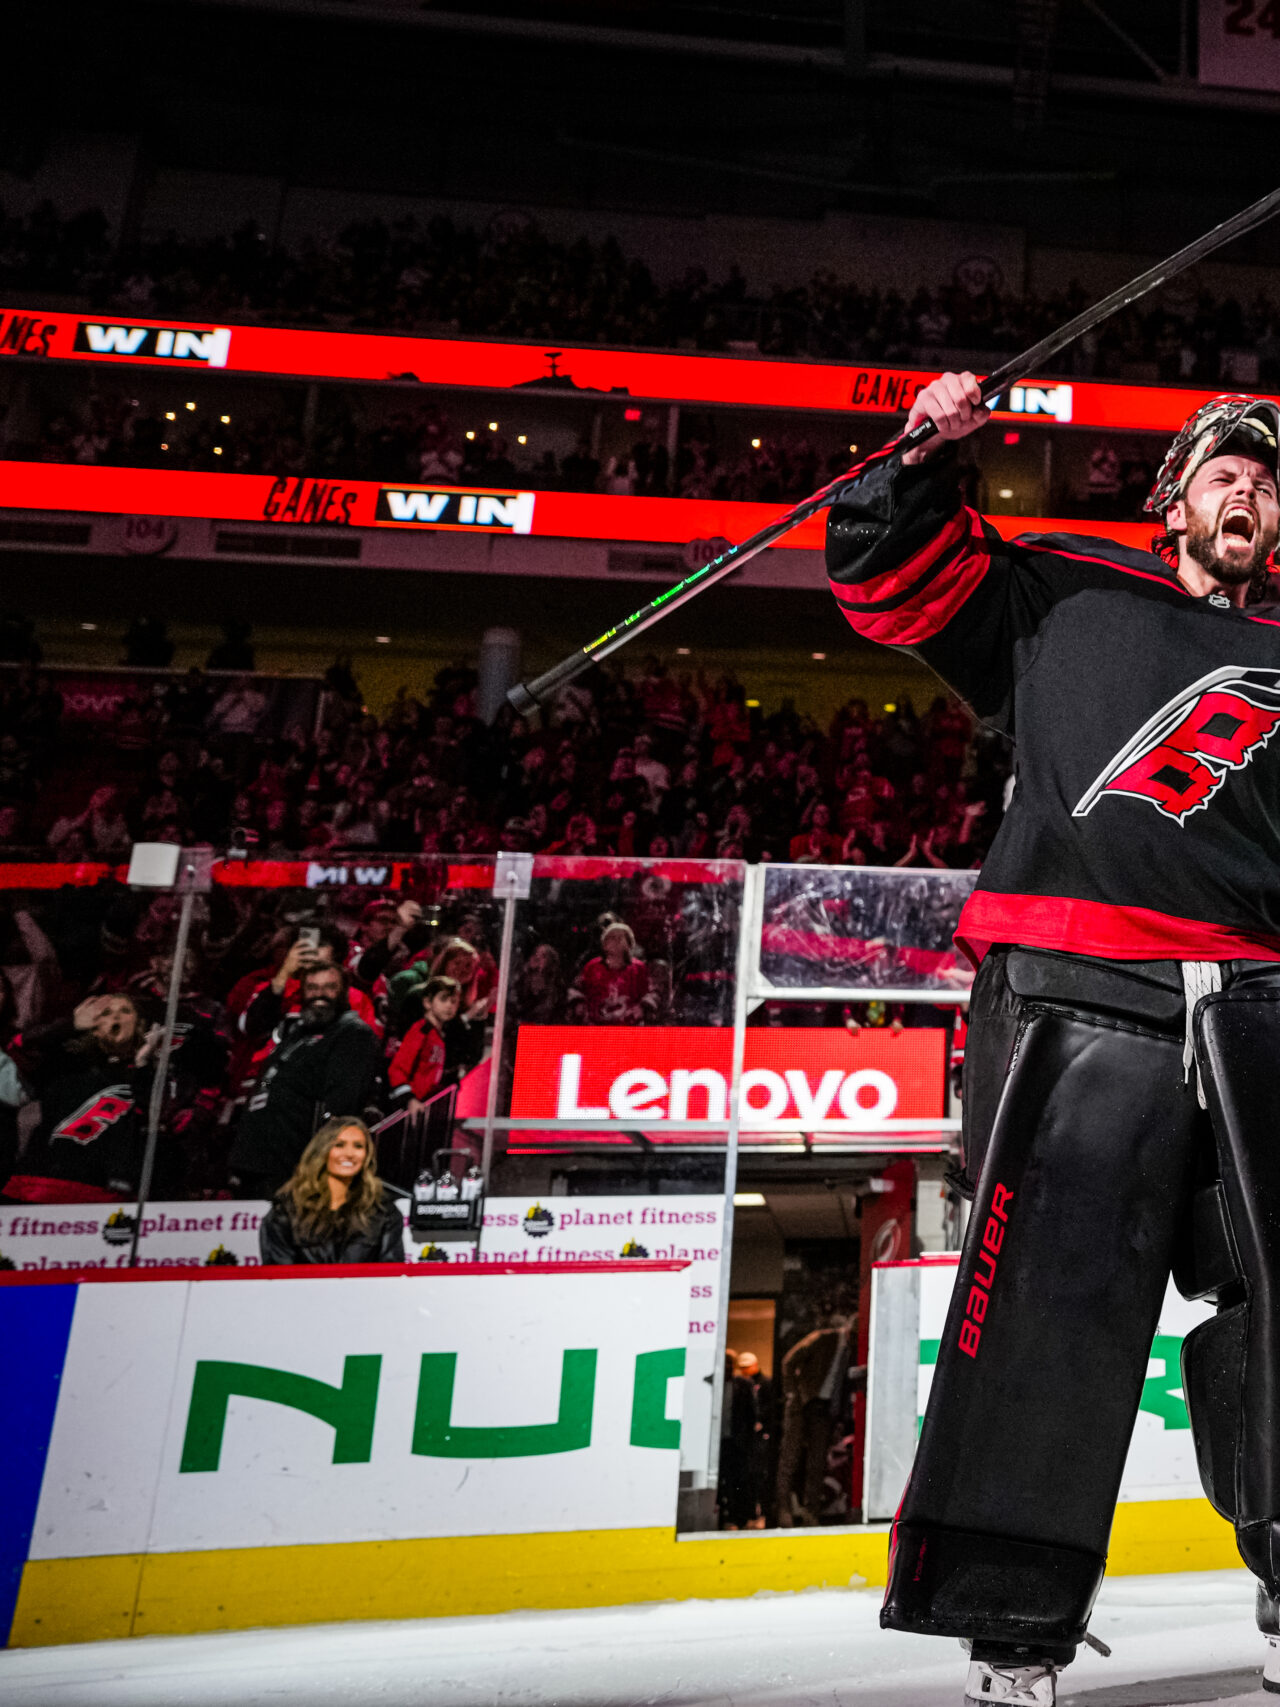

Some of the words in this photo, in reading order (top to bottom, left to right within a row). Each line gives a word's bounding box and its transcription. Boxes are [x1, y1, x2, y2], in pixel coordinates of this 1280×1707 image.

[0, 314, 57, 356] NES
[86, 325, 231, 367] WIN
[985, 385, 1072, 422] IN
[263, 476, 358, 524] CANES
[386, 491, 535, 534] WIN
[557, 1053, 899, 1120] Lenovo
[8, 1216, 99, 1236] fitness
[139, 1213, 224, 1237] planet
[559, 1208, 632, 1231] planet
[640, 1207, 717, 1225] fitness
[655, 1244, 719, 1261] plane
